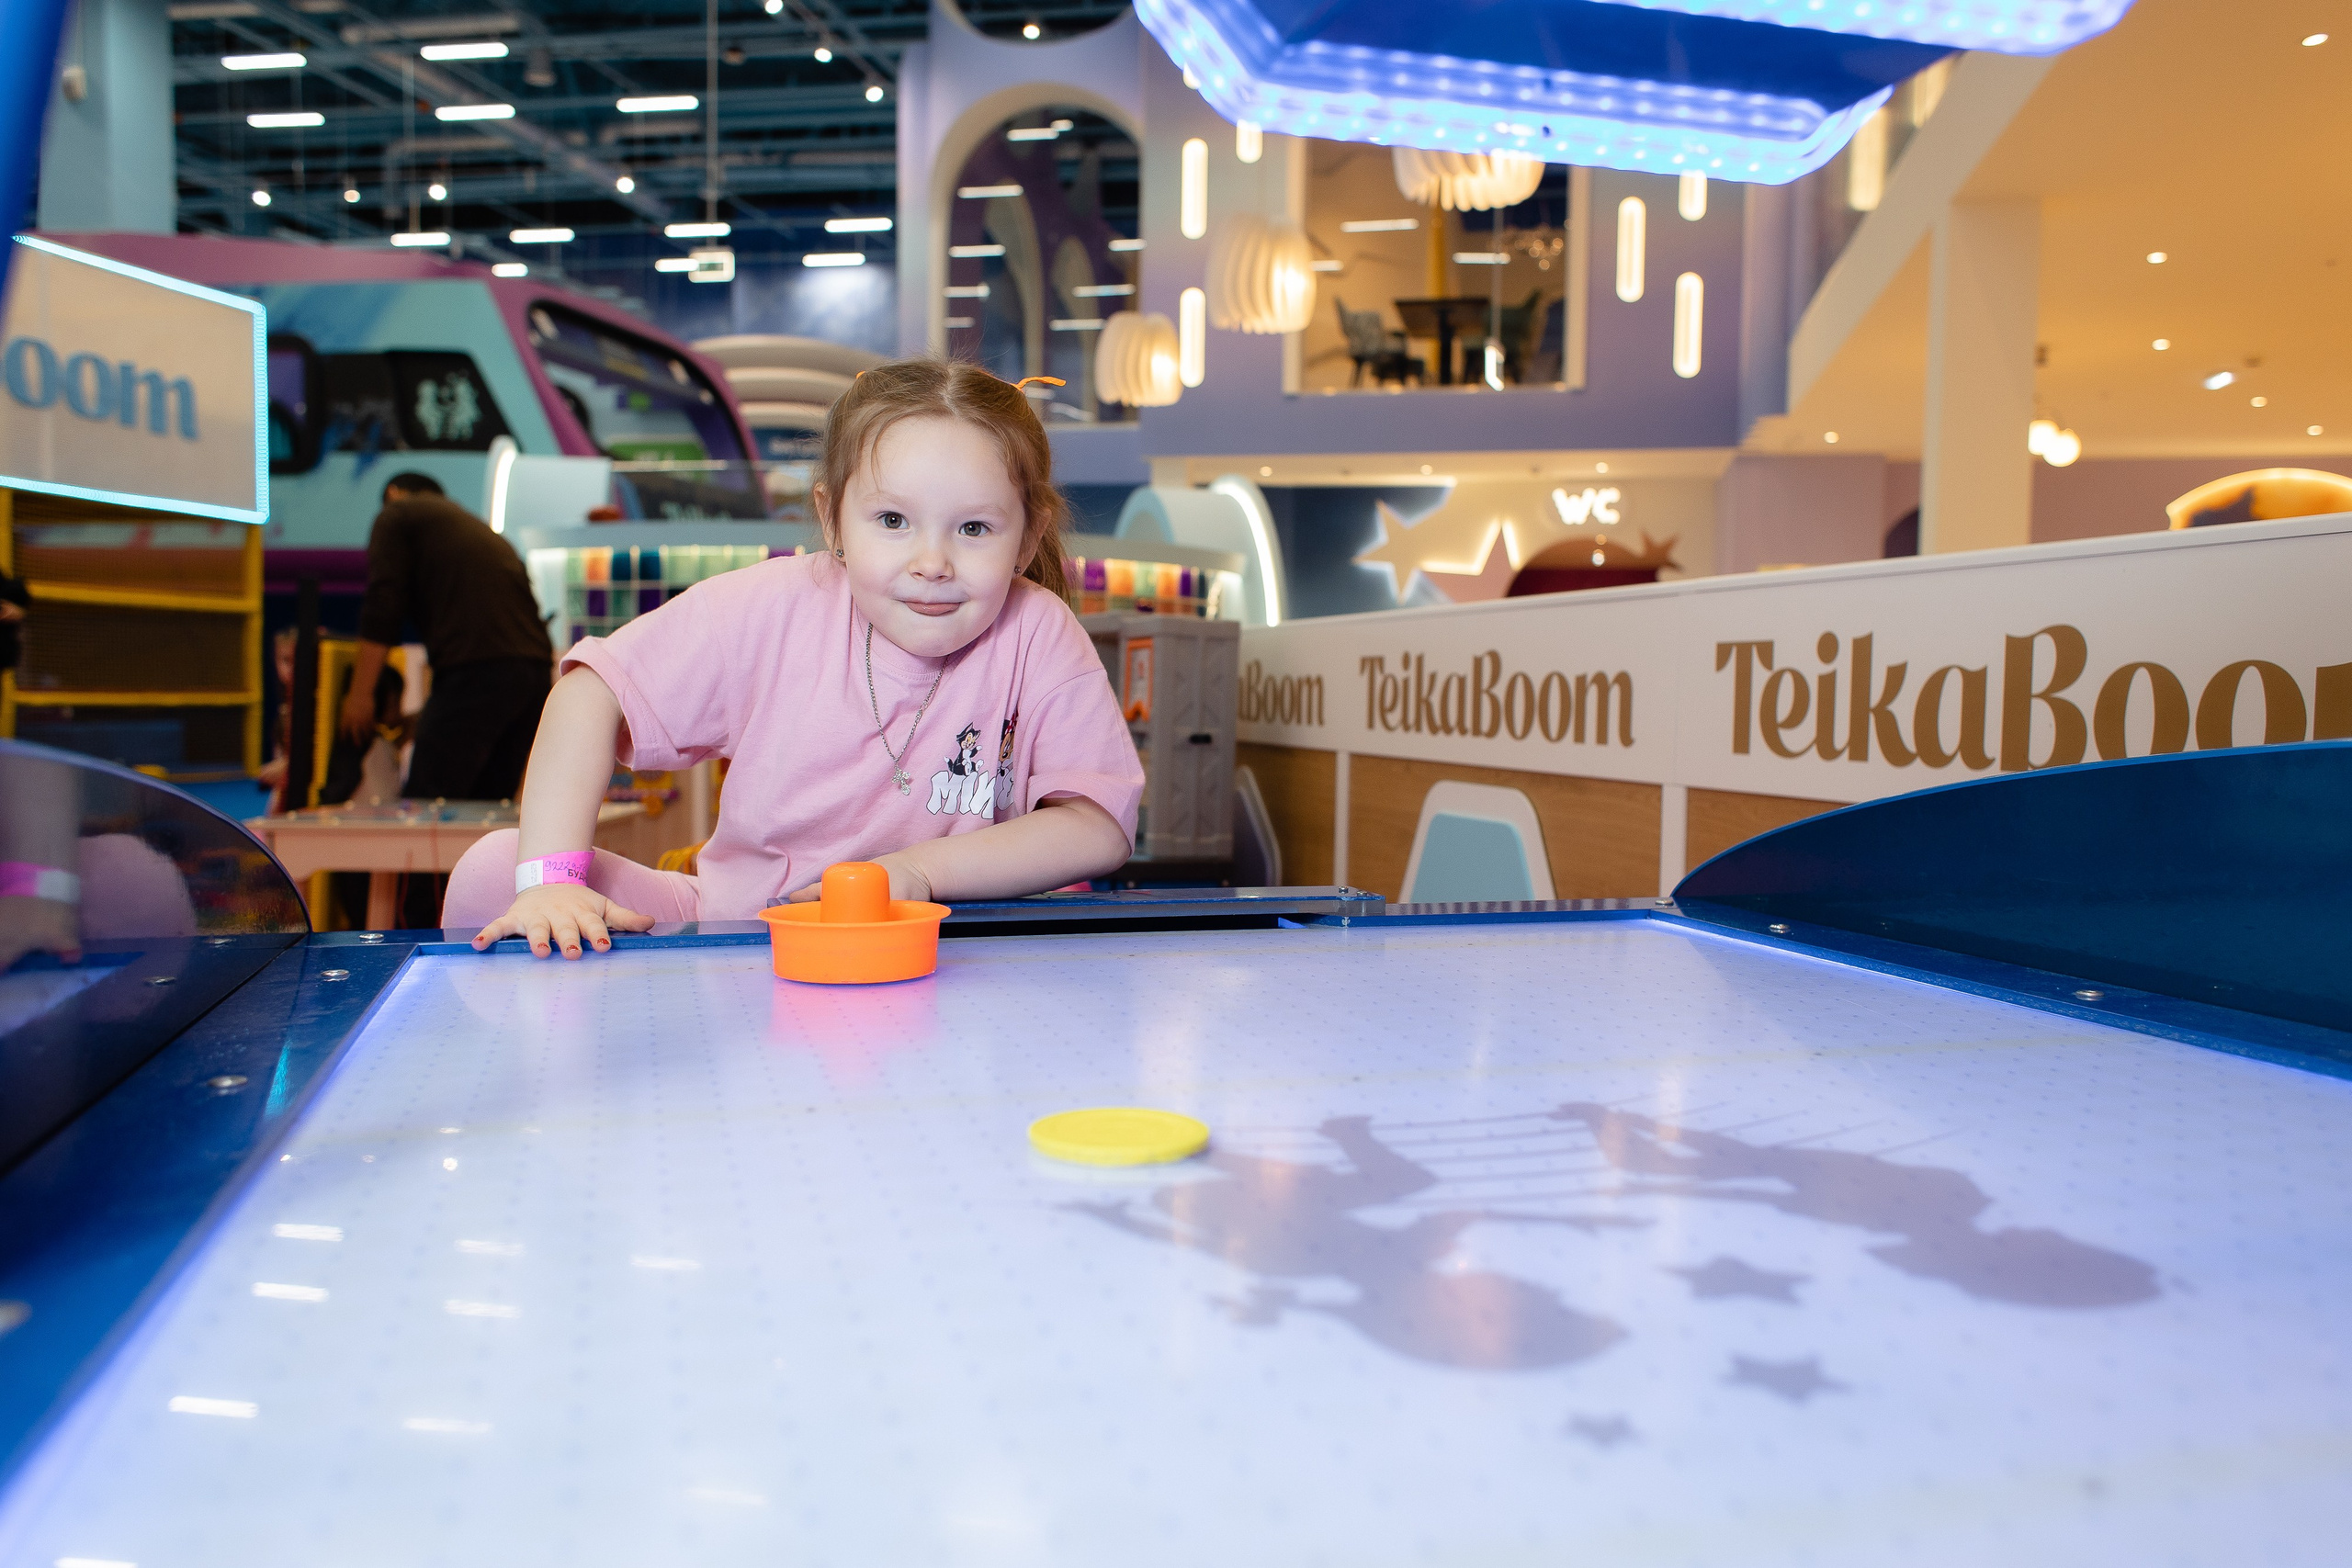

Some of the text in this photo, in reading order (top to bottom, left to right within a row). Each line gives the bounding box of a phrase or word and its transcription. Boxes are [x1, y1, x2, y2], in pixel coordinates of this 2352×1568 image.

[0, 335, 199, 440] oom
[1552, 487, 1621, 525] WC
[1360, 649, 1634, 748] TeikaBoom
[568, 868, 587, 882] БУД
